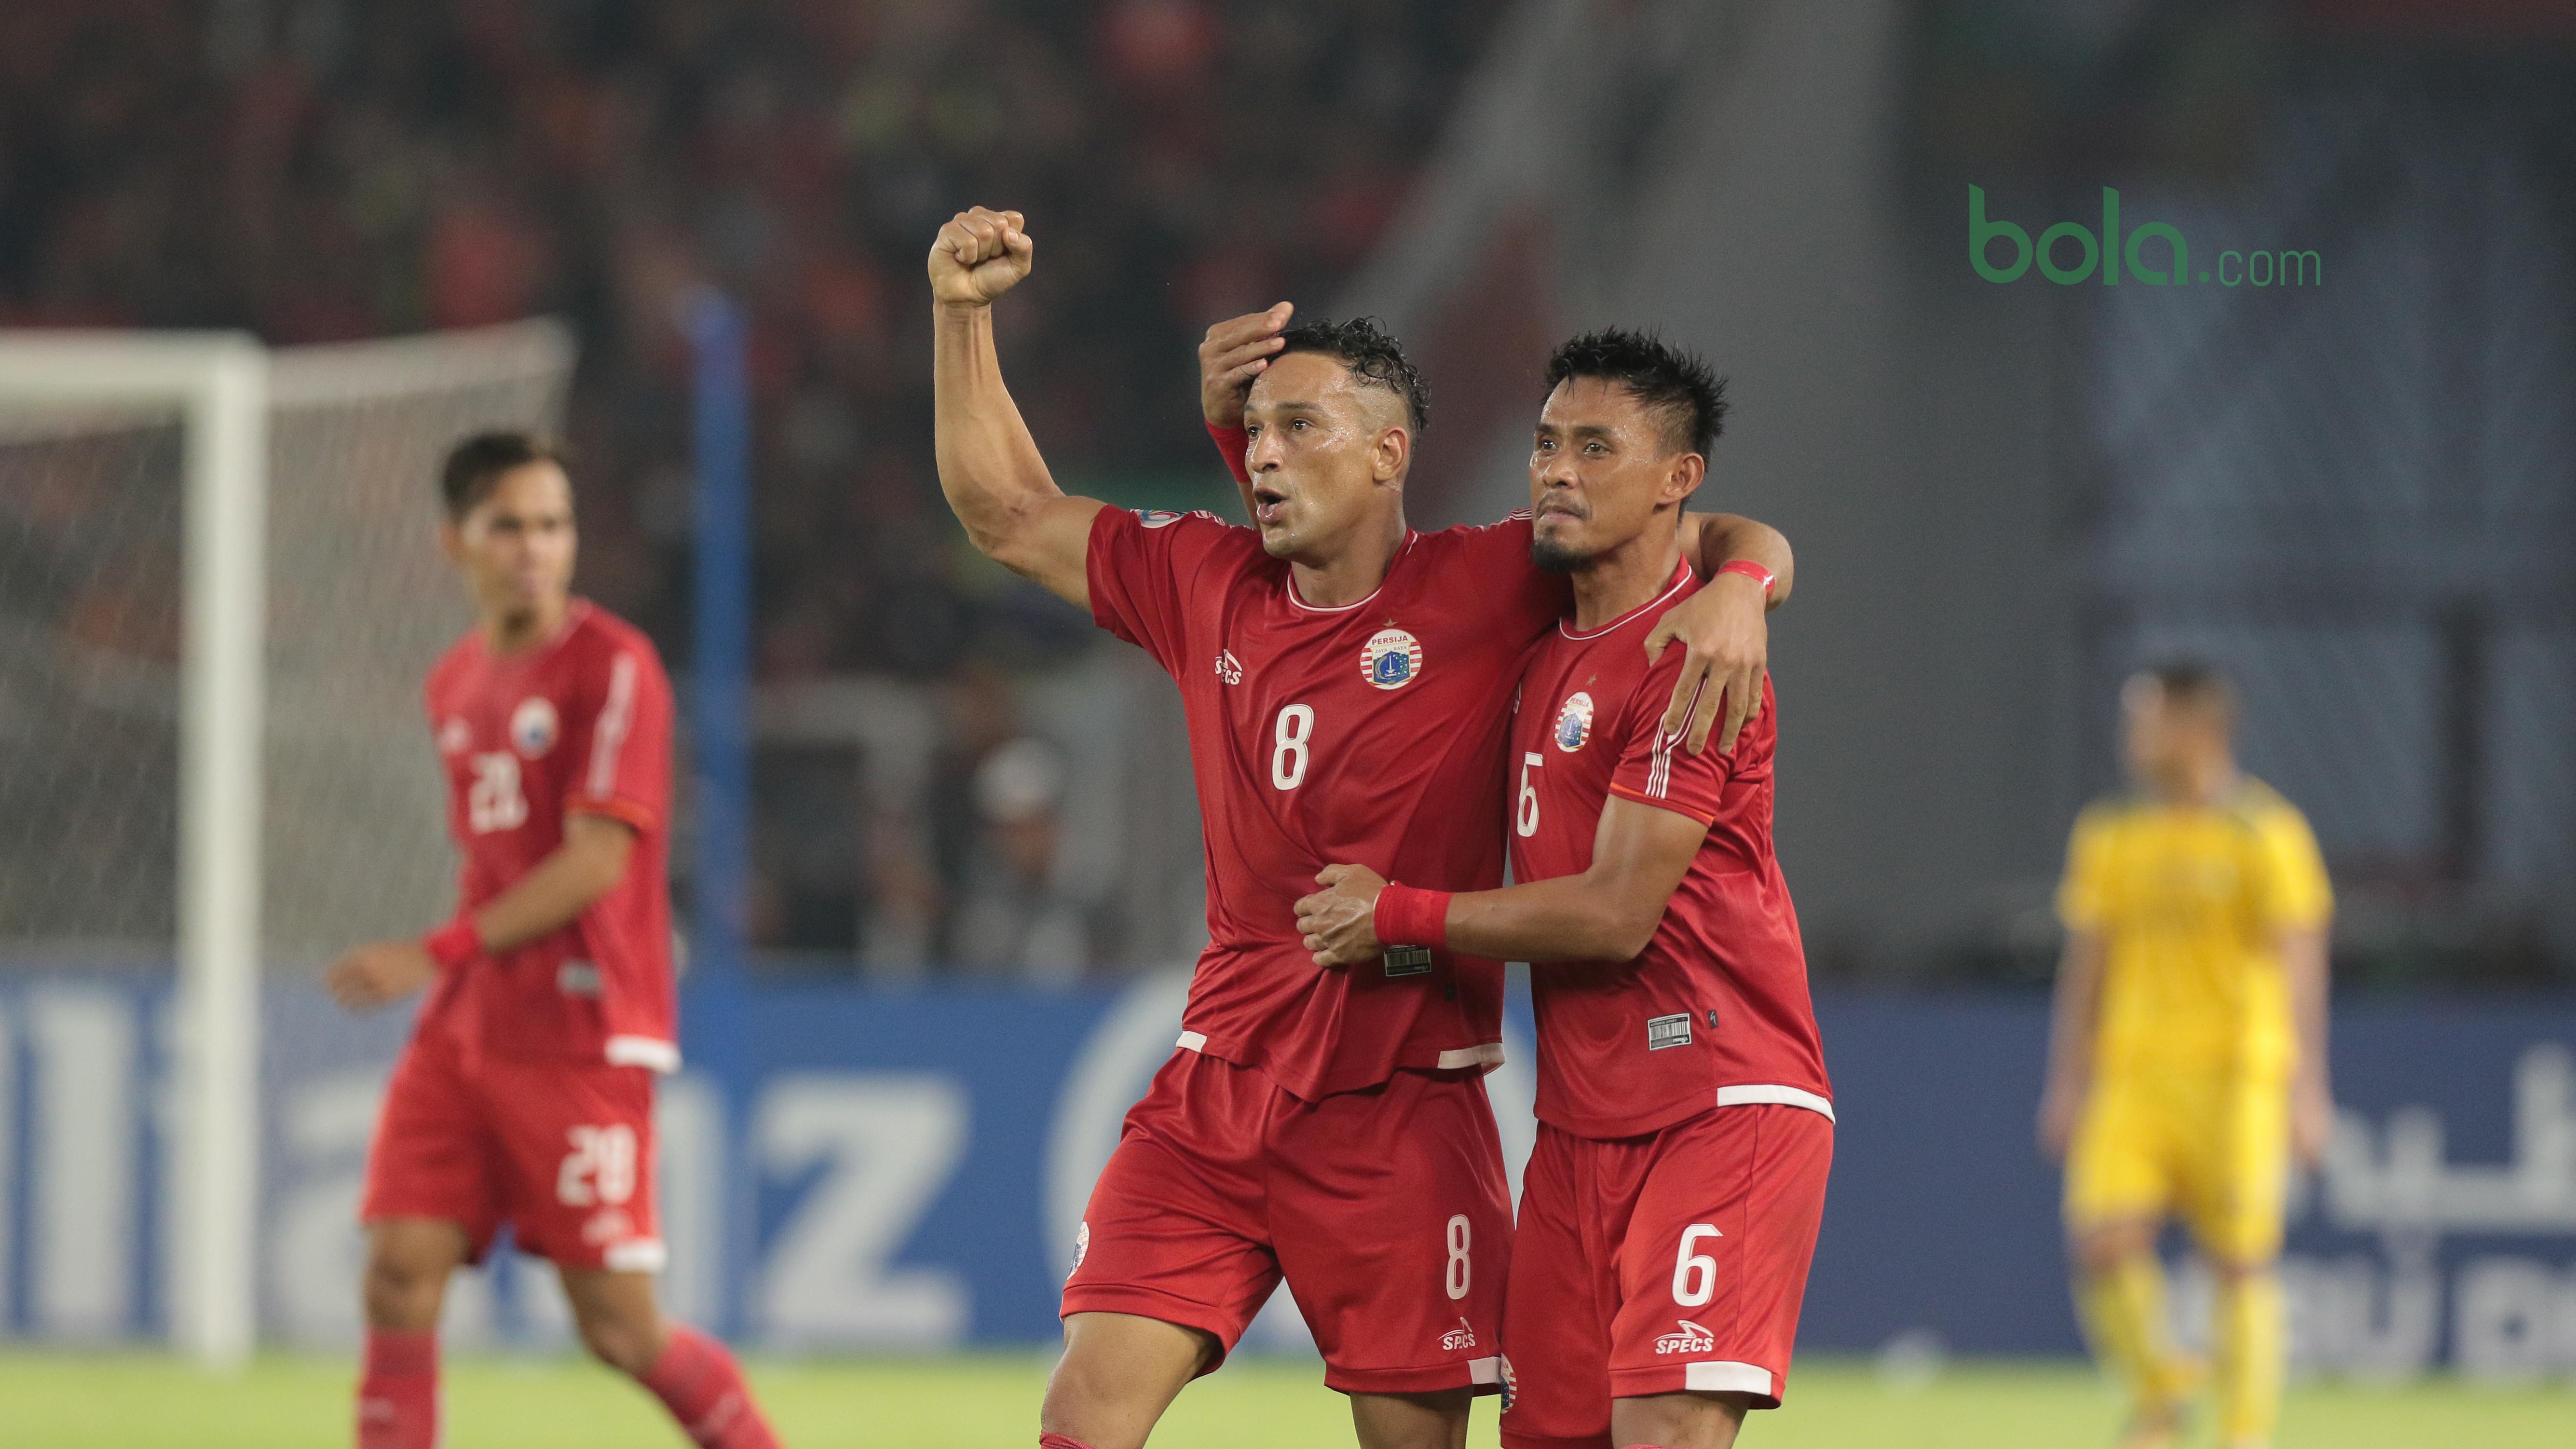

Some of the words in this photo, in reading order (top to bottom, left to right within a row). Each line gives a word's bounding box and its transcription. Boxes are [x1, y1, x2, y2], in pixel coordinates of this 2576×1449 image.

[1372, 635, 1408, 645] PERSIJA
[1570, 697, 1590, 708] PERSIJA
[1271, 703, 1314, 791] 8
[1517, 752, 1543, 838] 6
[1446, 1214, 1471, 1300] 8
[1672, 1223, 1723, 1307] 6
[1655, 1337, 1714, 1354] SPECS
